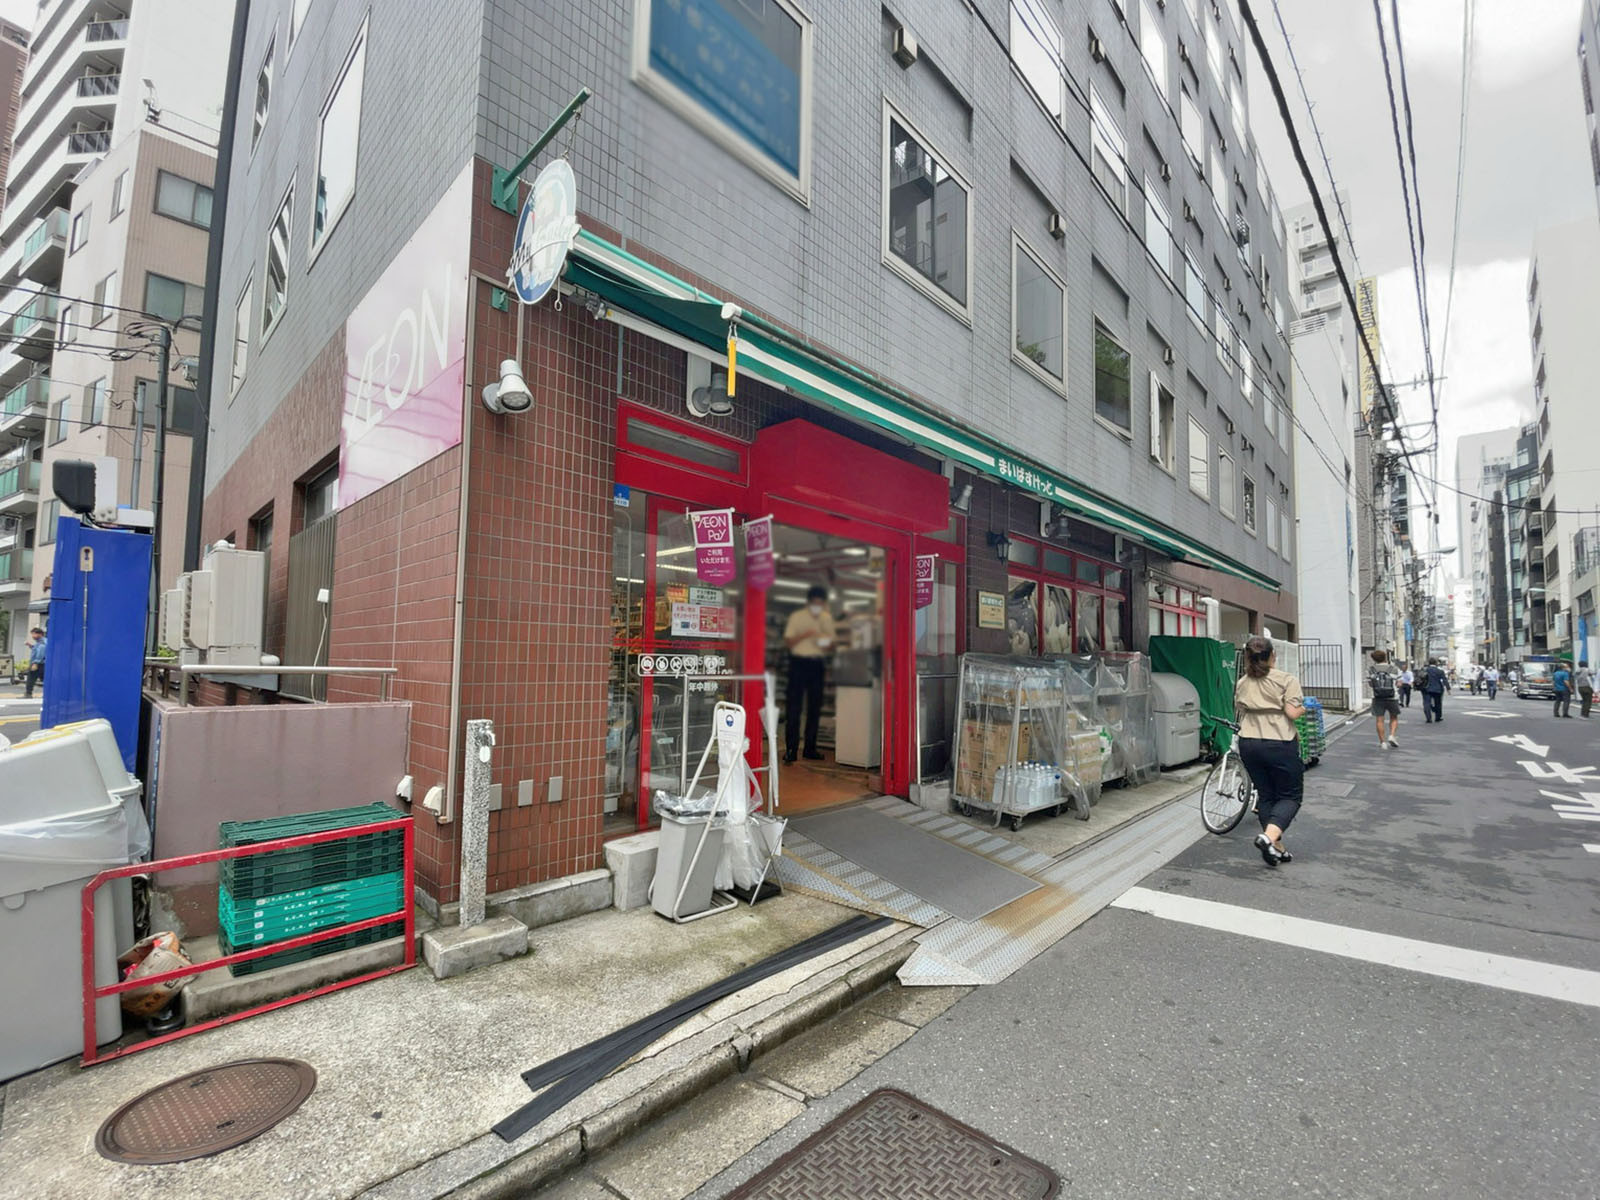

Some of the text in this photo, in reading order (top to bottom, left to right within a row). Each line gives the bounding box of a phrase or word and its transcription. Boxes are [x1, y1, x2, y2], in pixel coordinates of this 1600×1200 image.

[998, 458, 1053, 496] まいばすけっと
[708, 529, 726, 541] Pay
